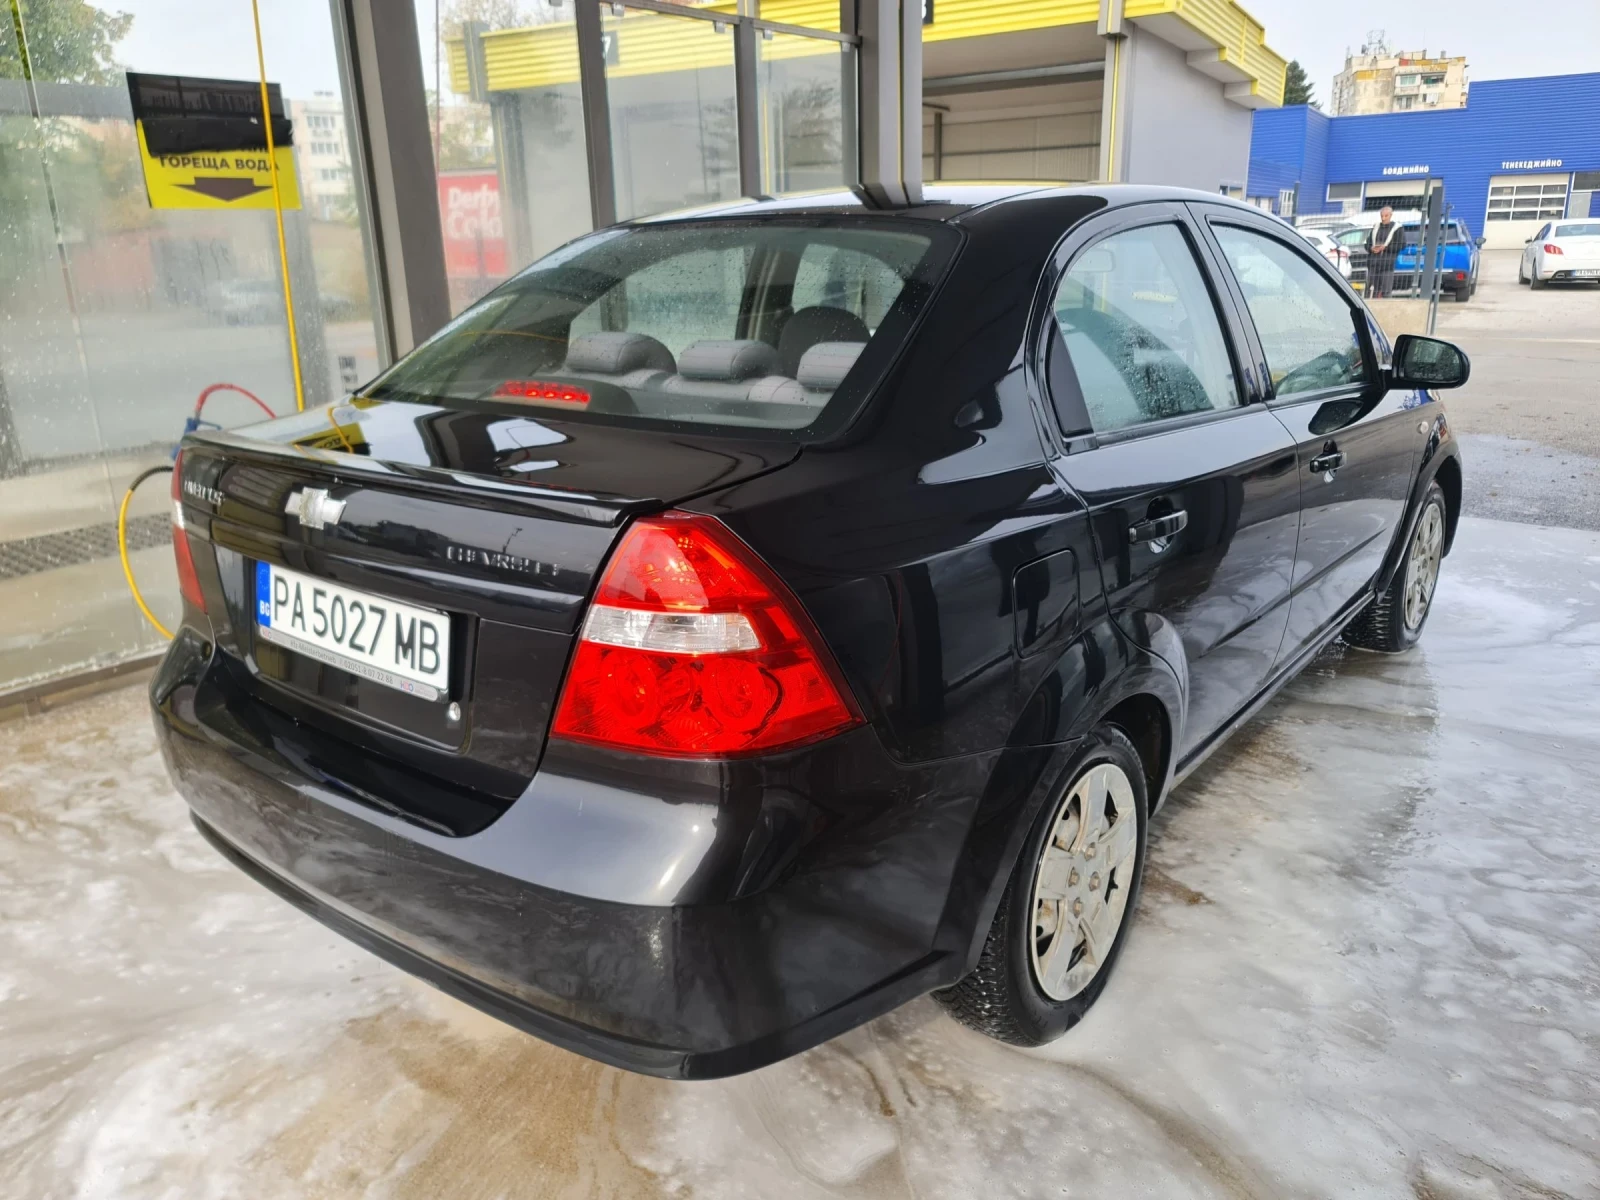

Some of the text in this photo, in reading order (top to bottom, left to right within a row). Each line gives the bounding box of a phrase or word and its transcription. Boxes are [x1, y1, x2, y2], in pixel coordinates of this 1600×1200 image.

[160, 155, 279, 172] ГОРЕЩА ВОДА
[1383, 165, 1430, 175] БОЯДЖИЙНО
[1502, 159, 1562, 169] ТЕНЕКЕДЖИЙНО
[259, 600, 270, 616] BG
[274, 574, 441, 675] PA 5027 MB
